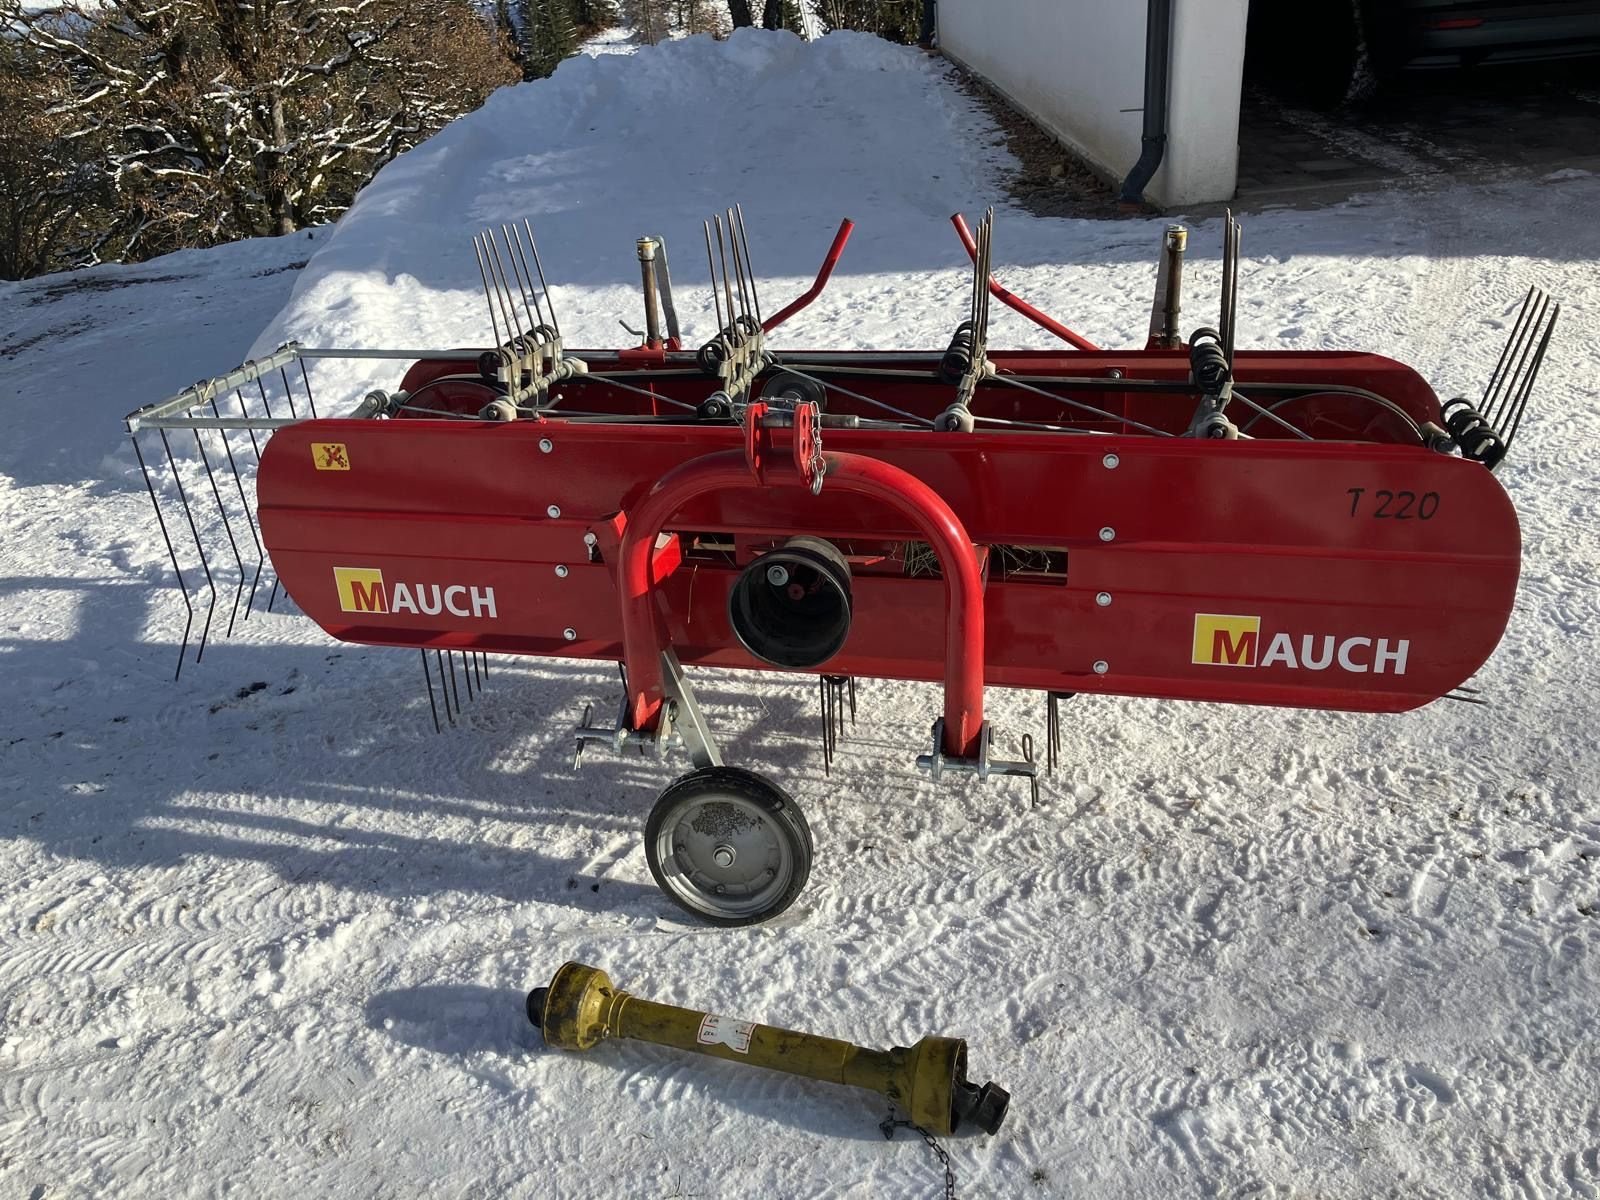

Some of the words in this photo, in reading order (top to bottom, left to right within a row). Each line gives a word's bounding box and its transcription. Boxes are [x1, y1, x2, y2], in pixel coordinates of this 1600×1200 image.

[1346, 487, 1365, 518] T
[1373, 490, 1440, 520] 220
[350, 580, 498, 619] MAUCH
[1211, 629, 1410, 675] MAUCH
